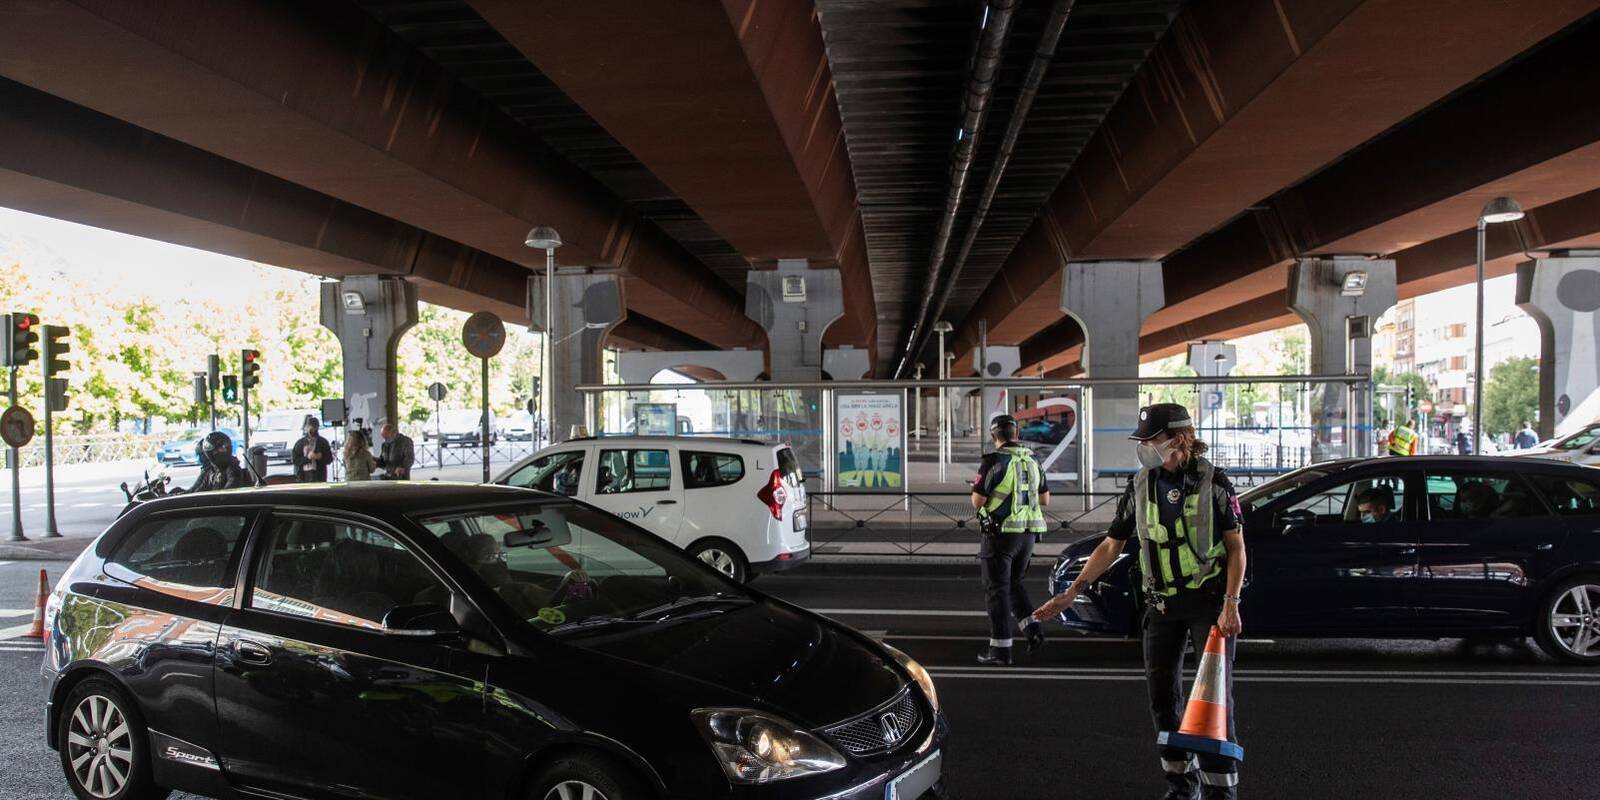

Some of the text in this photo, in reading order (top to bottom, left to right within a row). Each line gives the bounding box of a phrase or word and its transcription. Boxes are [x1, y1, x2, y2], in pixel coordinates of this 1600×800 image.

[1207, 393, 1219, 408] P
[757, 460, 764, 470] L
[165, 746, 216, 764] Sport
